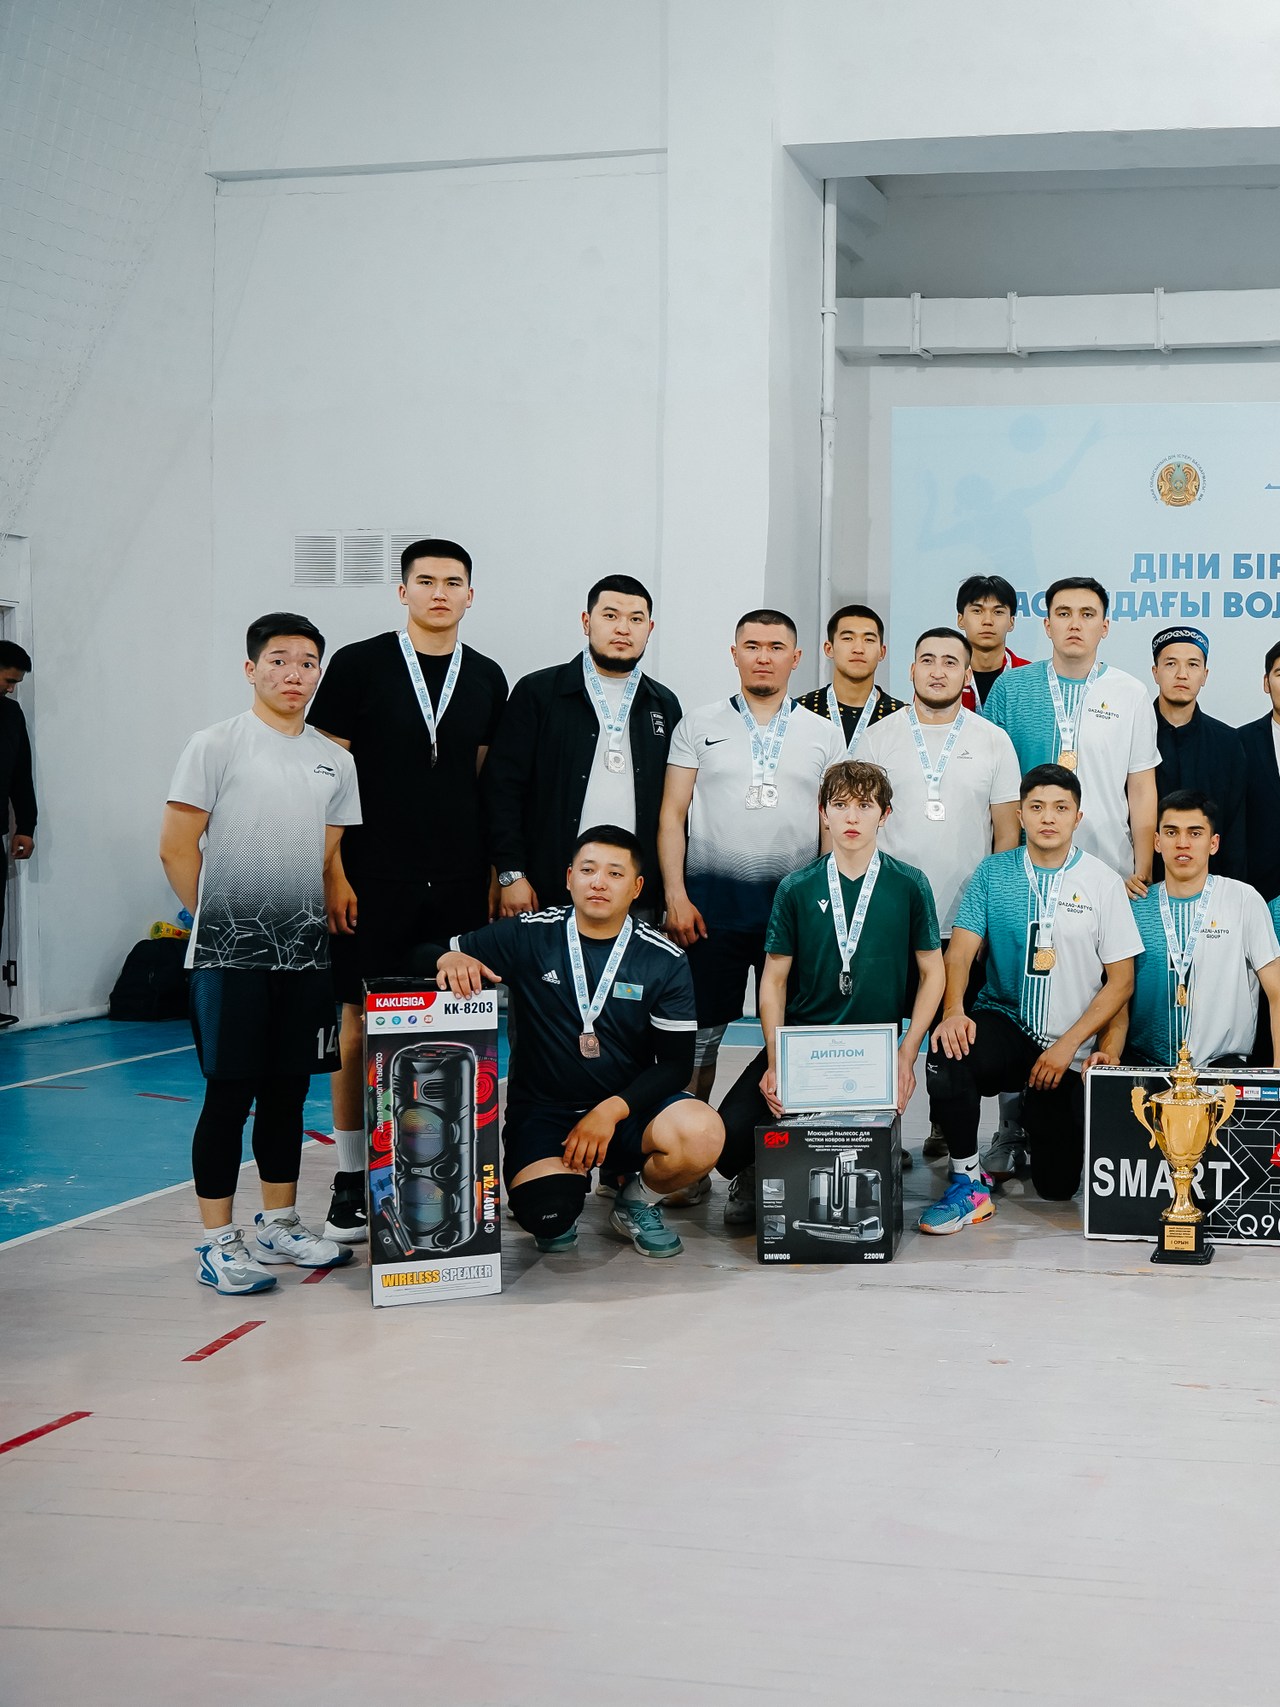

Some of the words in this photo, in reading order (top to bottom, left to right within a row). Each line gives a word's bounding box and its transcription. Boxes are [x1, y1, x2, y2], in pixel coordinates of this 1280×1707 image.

[1130, 552, 1221, 583] ДІНИ
[375, 996, 425, 1008] KAKUSIGA
[444, 1001, 493, 1015] KK-8203
[316, 1025, 338, 1060] 14
[810, 1048, 865, 1060] ДИПЛОМ
[376, 1083, 384, 1111] LIGHTING
[484, 1197, 495, 1220] 40W
[381, 1269, 441, 1288] WIRELESS
[441, 1265, 493, 1282] SPEAKER
